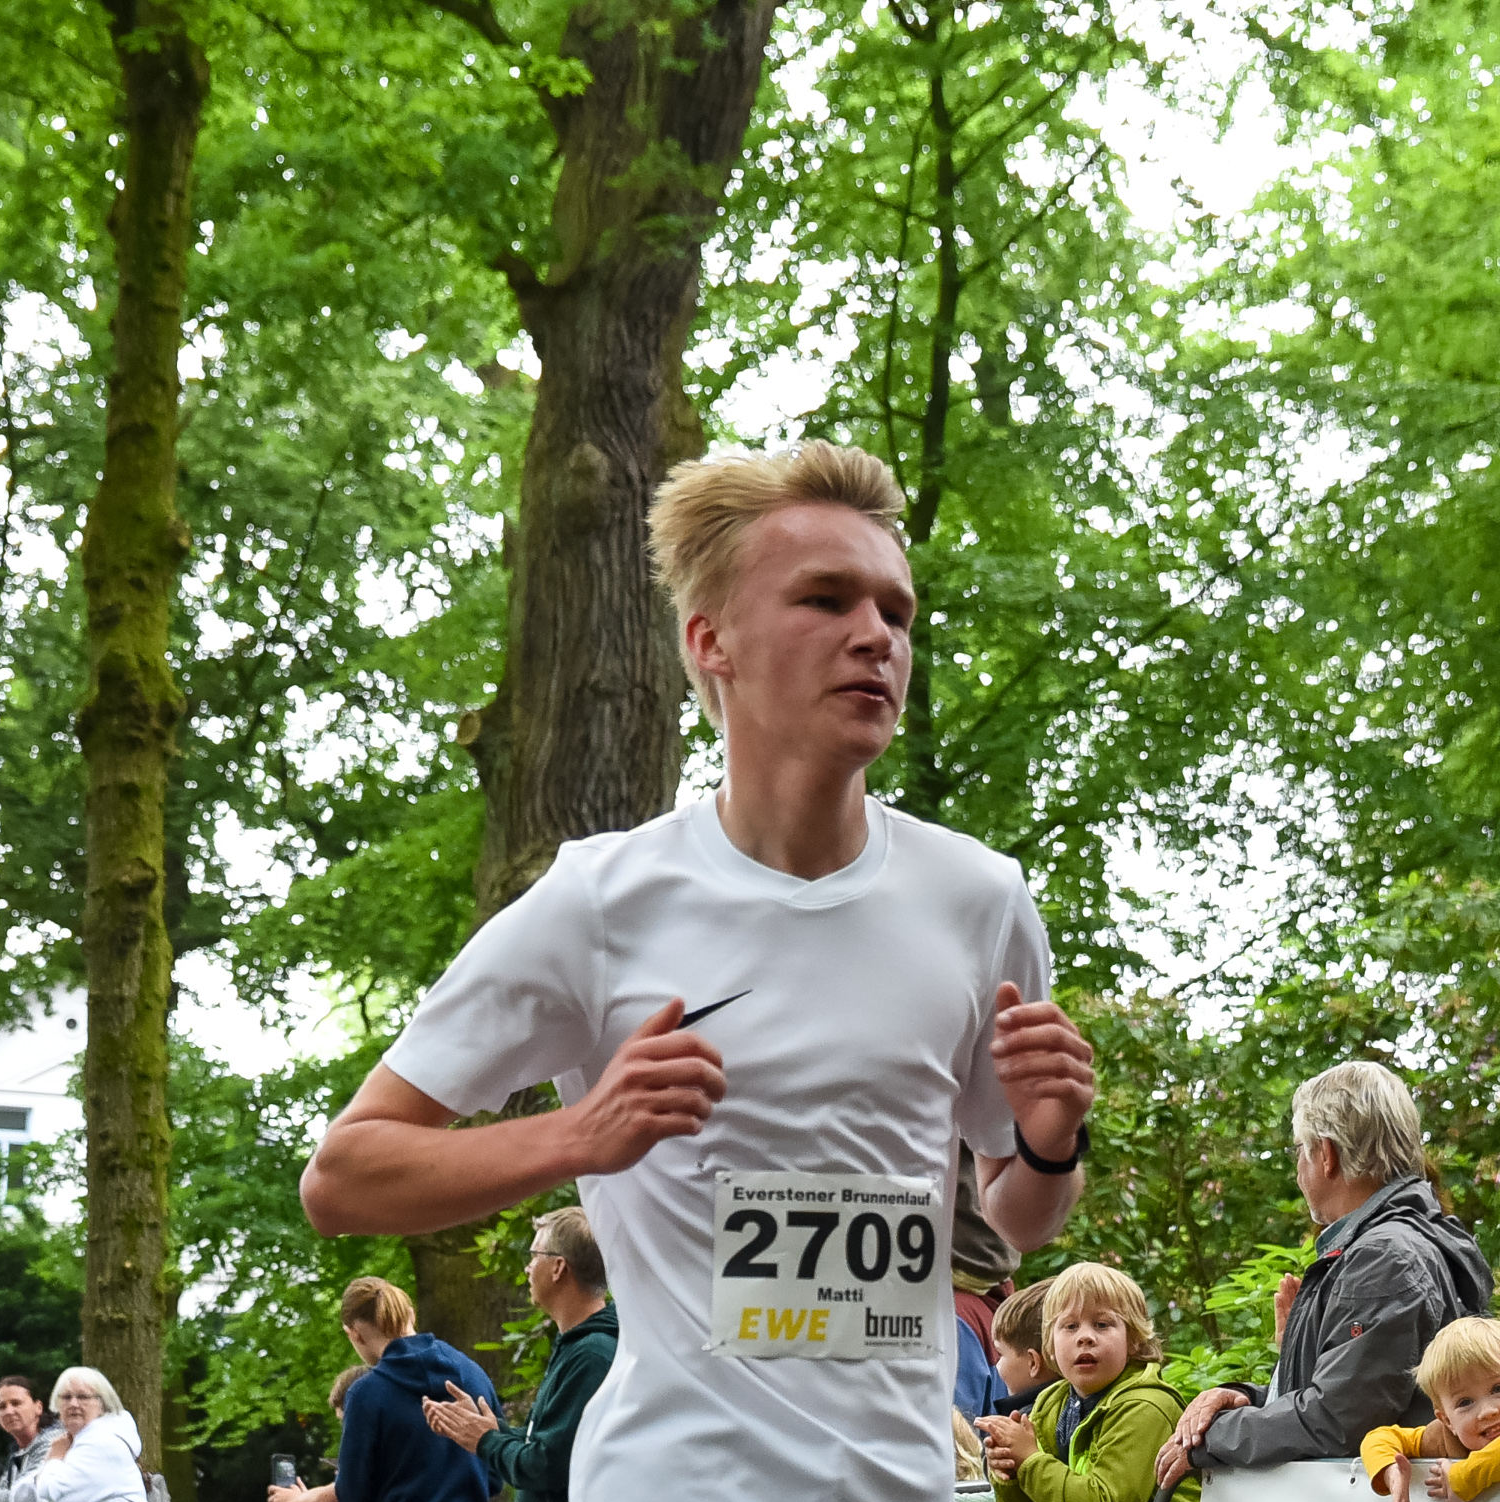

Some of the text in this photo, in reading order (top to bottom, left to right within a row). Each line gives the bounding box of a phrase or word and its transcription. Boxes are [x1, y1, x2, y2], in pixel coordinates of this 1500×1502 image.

[733, 1187, 931, 1206] Everstener Brunnenlauf
[722, 1209, 935, 1283] 2709
[817, 1288, 864, 1302] Matti
[738, 1307, 830, 1341] EWE
[865, 1307, 922, 1338] bruns
